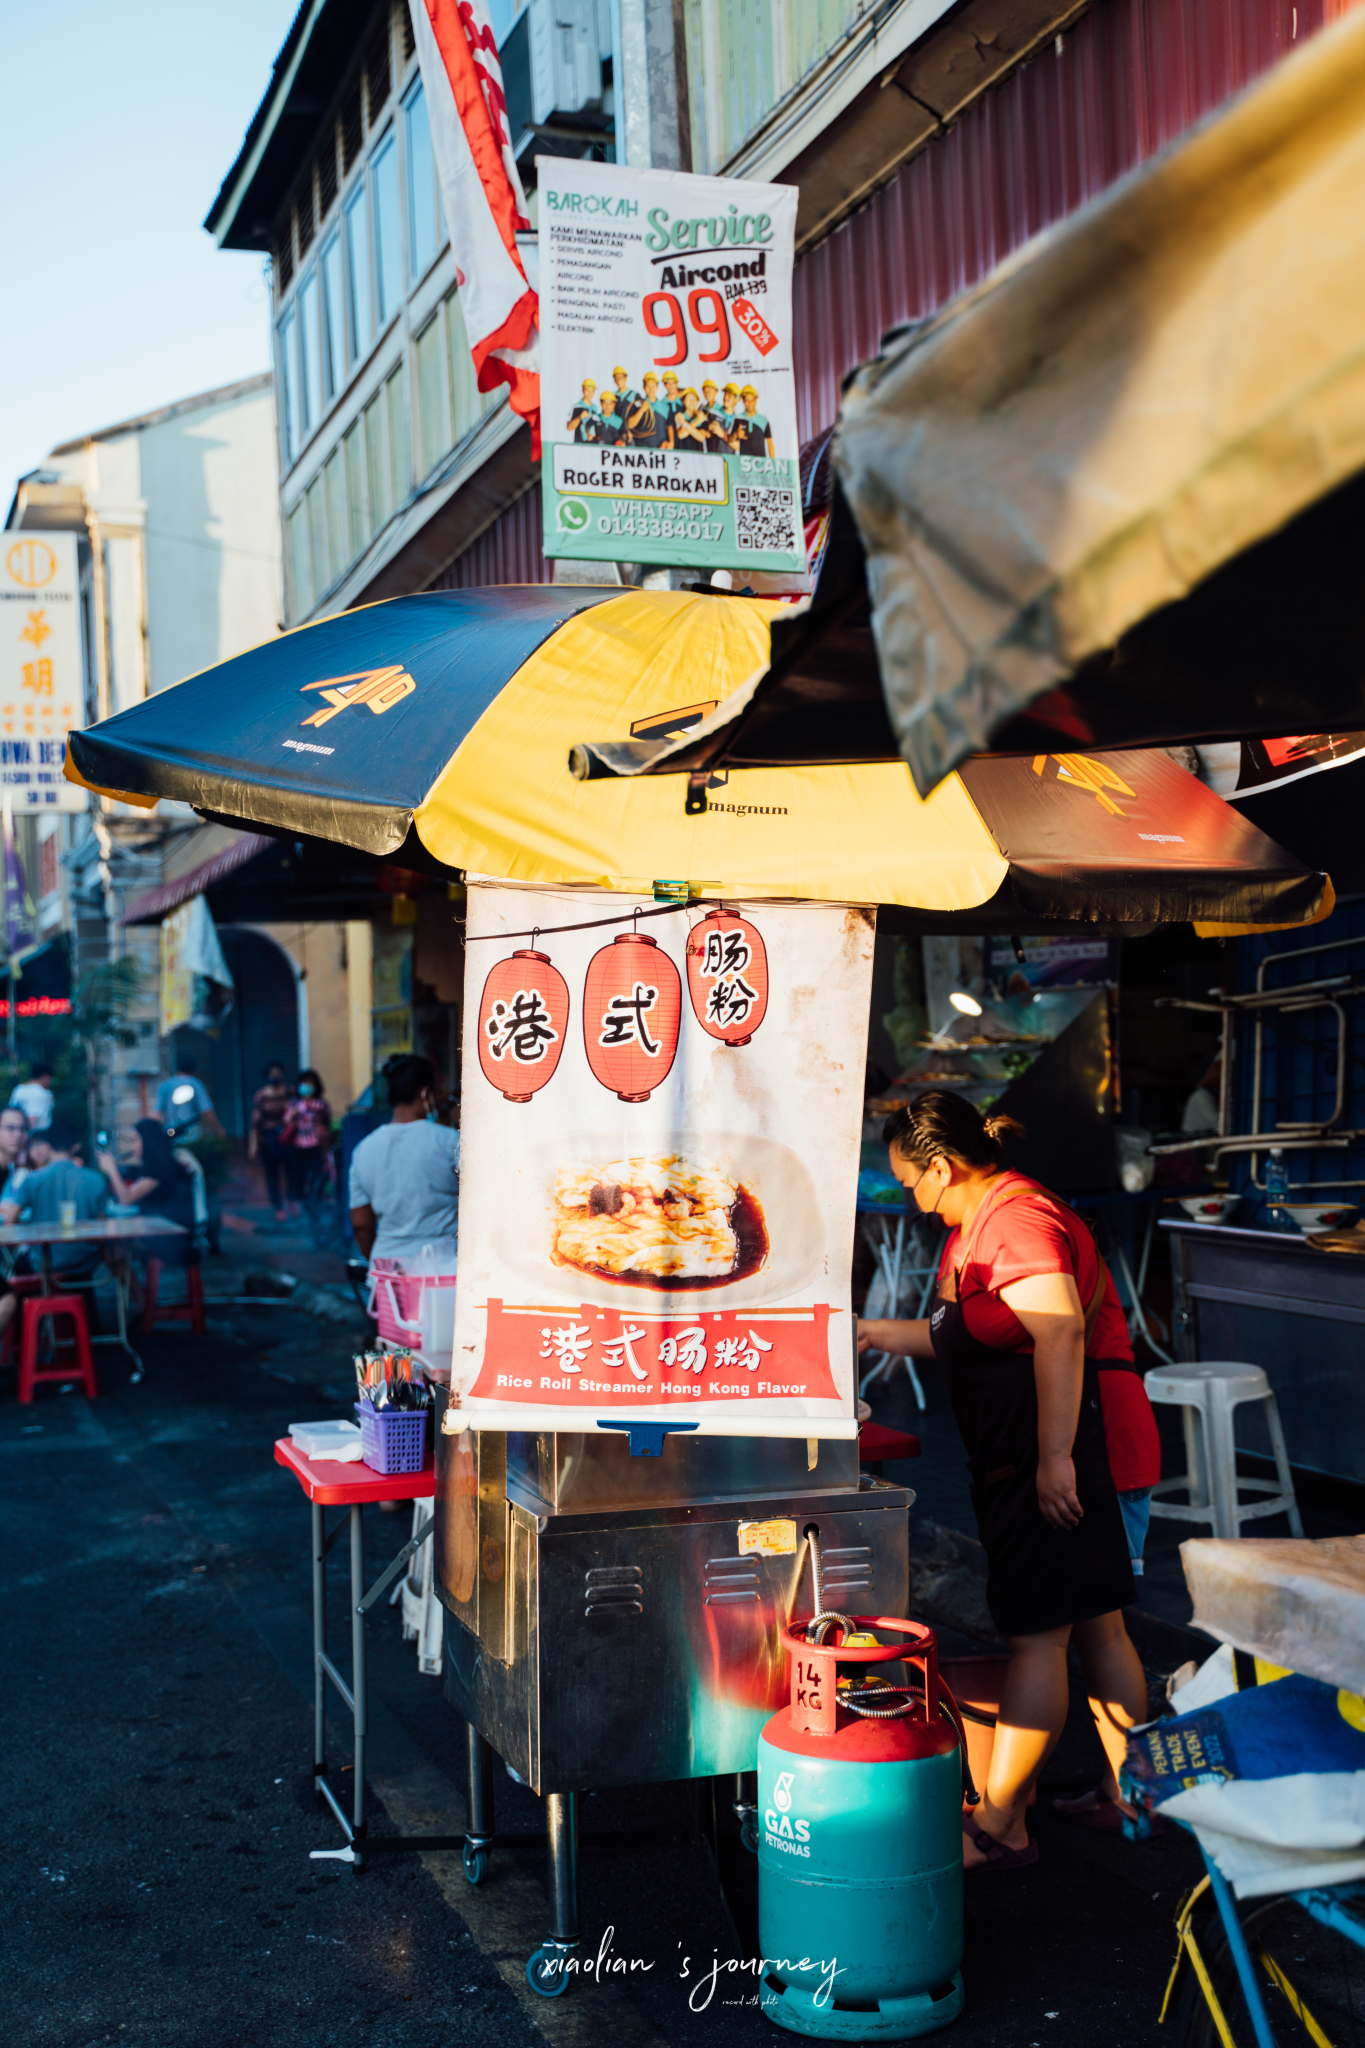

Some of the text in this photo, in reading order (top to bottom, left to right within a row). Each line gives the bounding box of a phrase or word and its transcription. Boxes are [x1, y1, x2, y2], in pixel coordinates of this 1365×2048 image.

[547, 190, 639, 219] BAROKAH
[550, 226, 642, 242] KAMI MENAWARKAN
[646, 204, 774, 251] Service
[557, 245, 624, 258] SERVIS AIRCOND
[557, 258, 611, 270] PEMASANGAN
[660, 252, 766, 289] Aircond
[557, 272, 594, 282] AIRCOND
[557, 285, 640, 299] BAIK PULIH AIRCOND
[557, 298, 626, 311] MENGENAL PASTI
[557, 311, 634, 324] MASALAH AIRCOND
[557, 324, 596, 334] ELEKTRIK
[642, 288, 731, 367] 99
[738, 305, 771, 345] 30%
[673, 457, 680, 471] ?
[740, 457, 789, 476] SCAN
[563, 468, 624, 489] ROGER
[632, 473, 717, 494] BAROKAH
[612, 499, 713, 522] WHATSAPP
[597, 515, 724, 541] 0143384017
[281, 739, 336, 756] magnum
[707, 800, 789, 817] magnum
[1137, 832, 1186, 844] magnum
[486, 931, 757, 1063] 港 式 肠粉
[539, 1321, 773, 1381] 港式肠粉
[496, 1375, 807, 1397] Rice Roll Streamer Hong Kong Flavor
[797, 1661, 821, 1687] 14
[797, 1688, 822, 1710] KG
[1146, 1730, 1170, 1775] PENANG
[1166, 1733, 1188, 1773] TRADE
[1183, 1730, 1206, 1769] EVENT
[1203, 1734, 1225, 1764] 2022
[764, 1808, 811, 1843] GAS
[764, 1831, 811, 1859] PETRONAS
